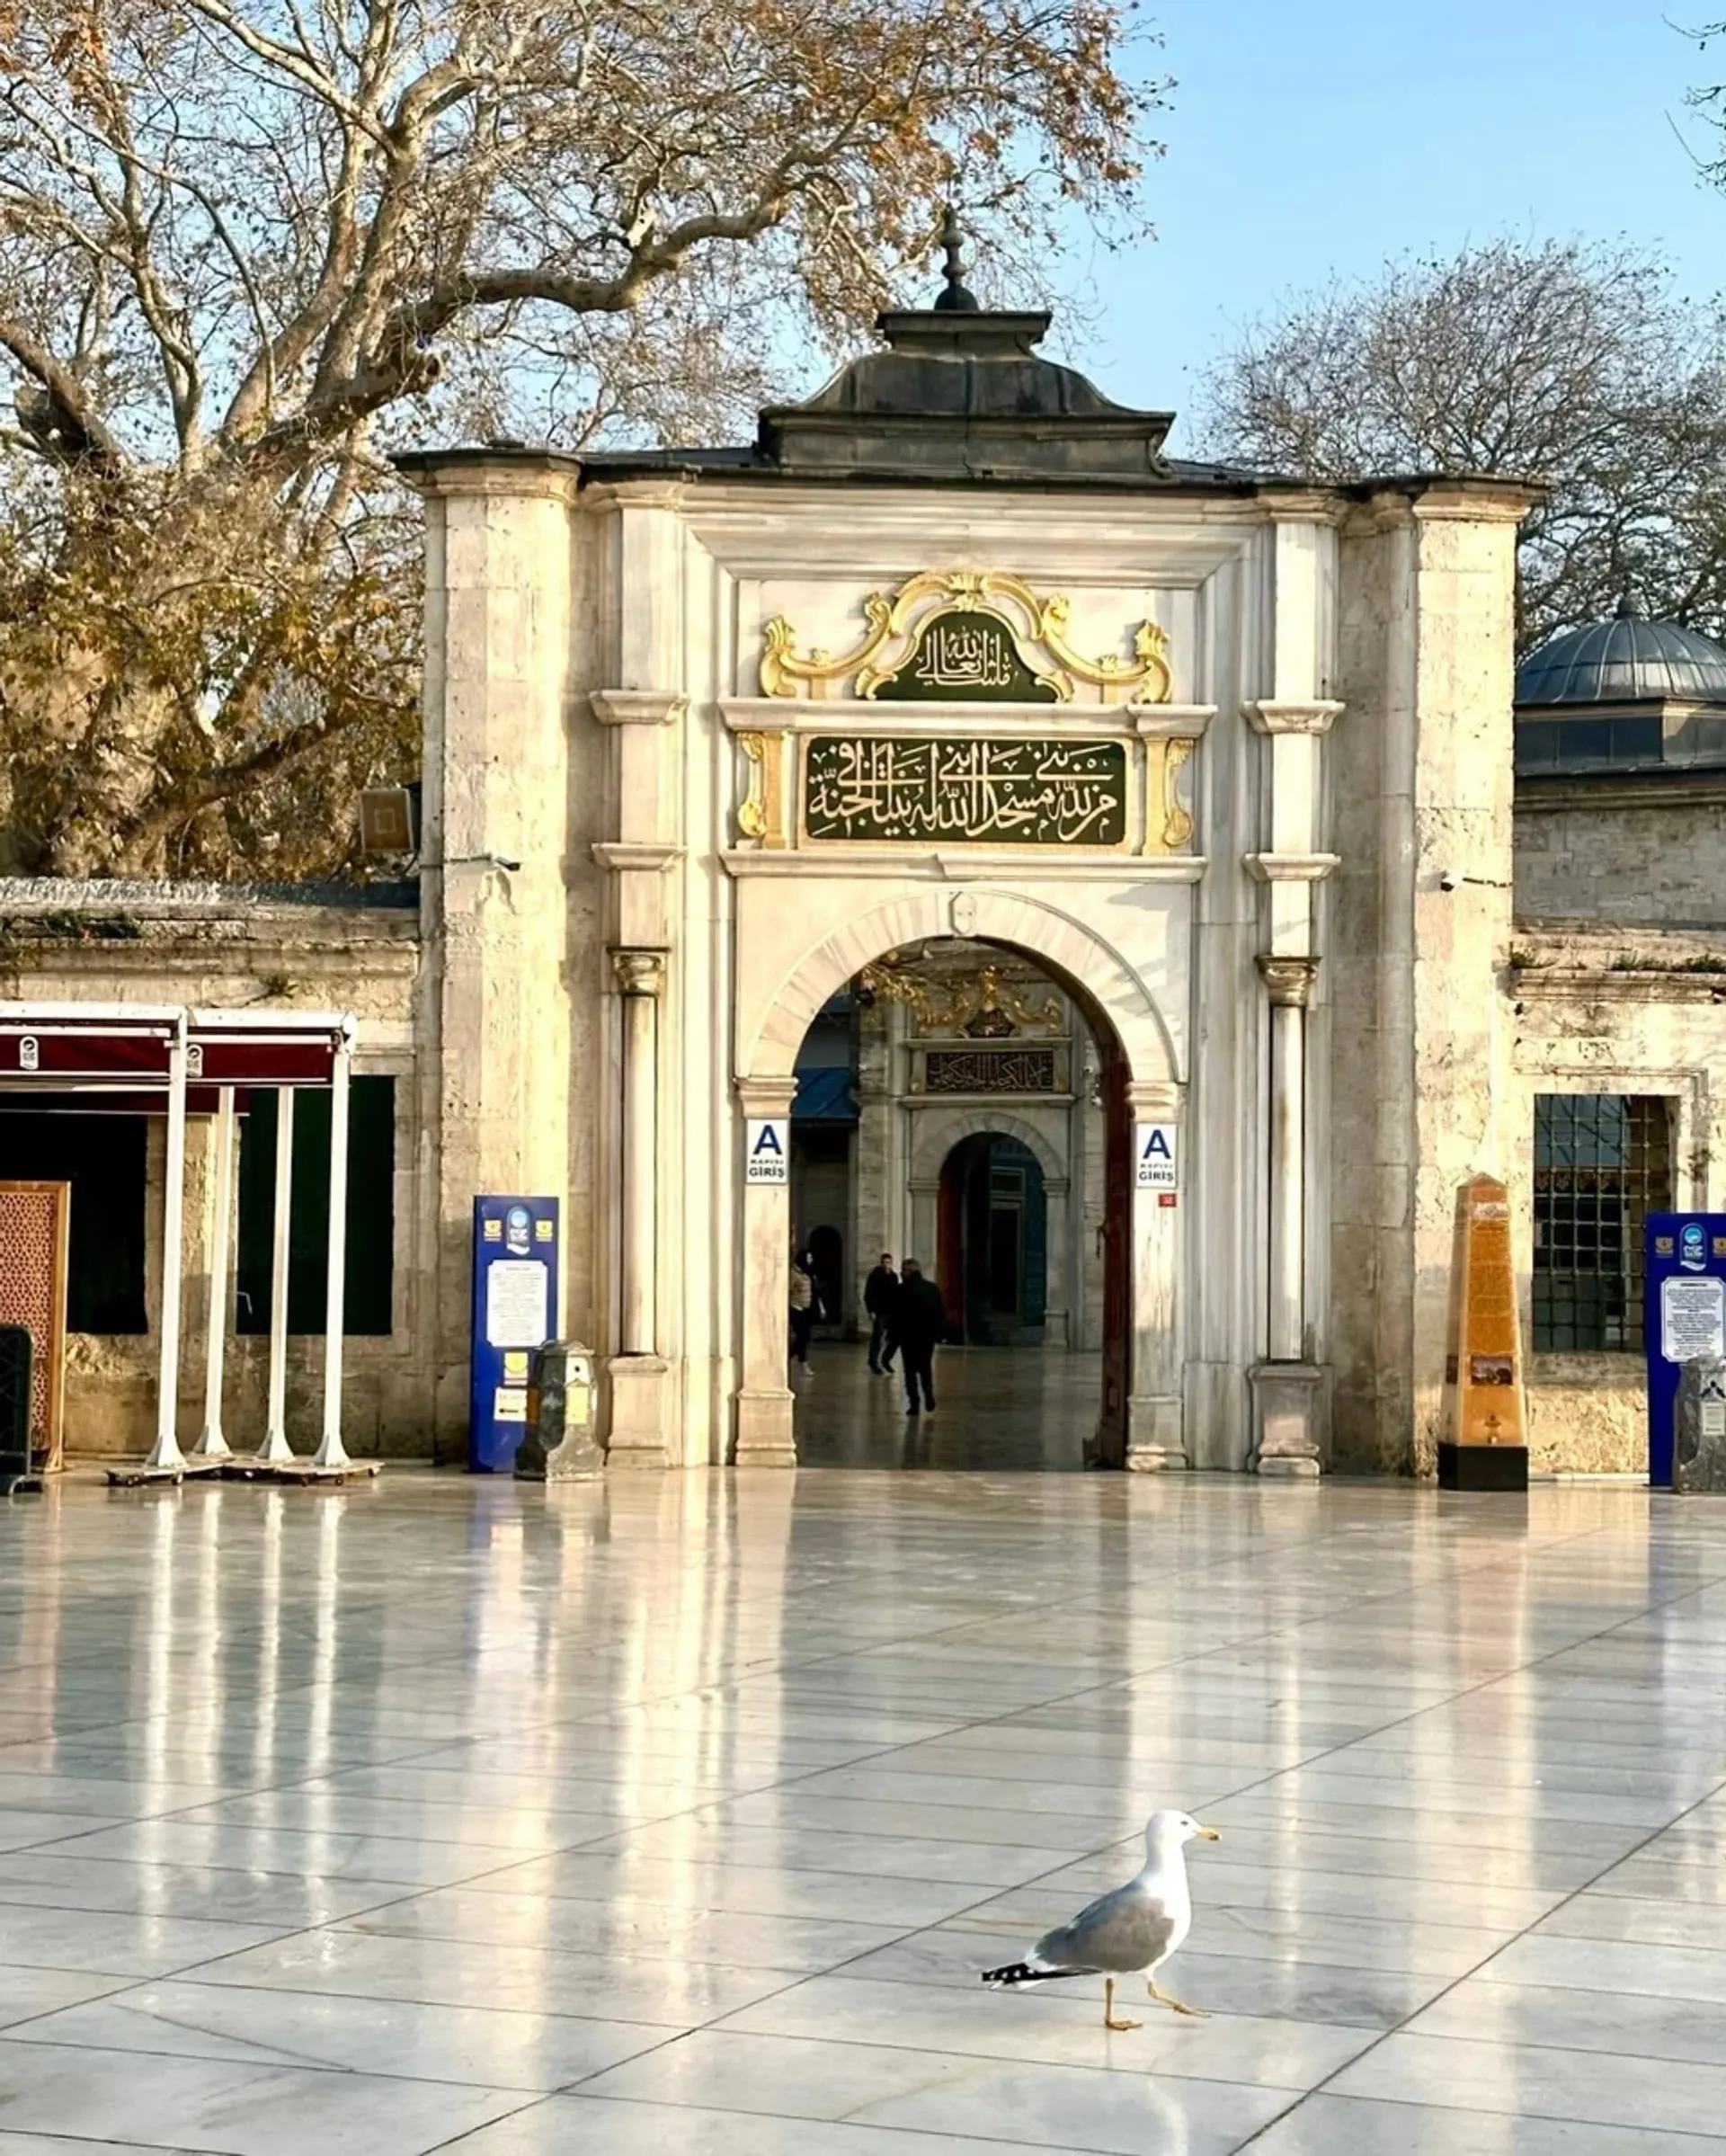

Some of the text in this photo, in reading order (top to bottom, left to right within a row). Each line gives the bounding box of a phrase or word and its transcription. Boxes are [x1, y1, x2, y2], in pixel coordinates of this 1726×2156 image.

[752, 1124, 782, 1155] A
[1143, 1128, 1171, 1160] A
[749, 1166, 785, 1178] GİRİŞ
[1138, 1171, 1174, 1183] GİRİŞ
